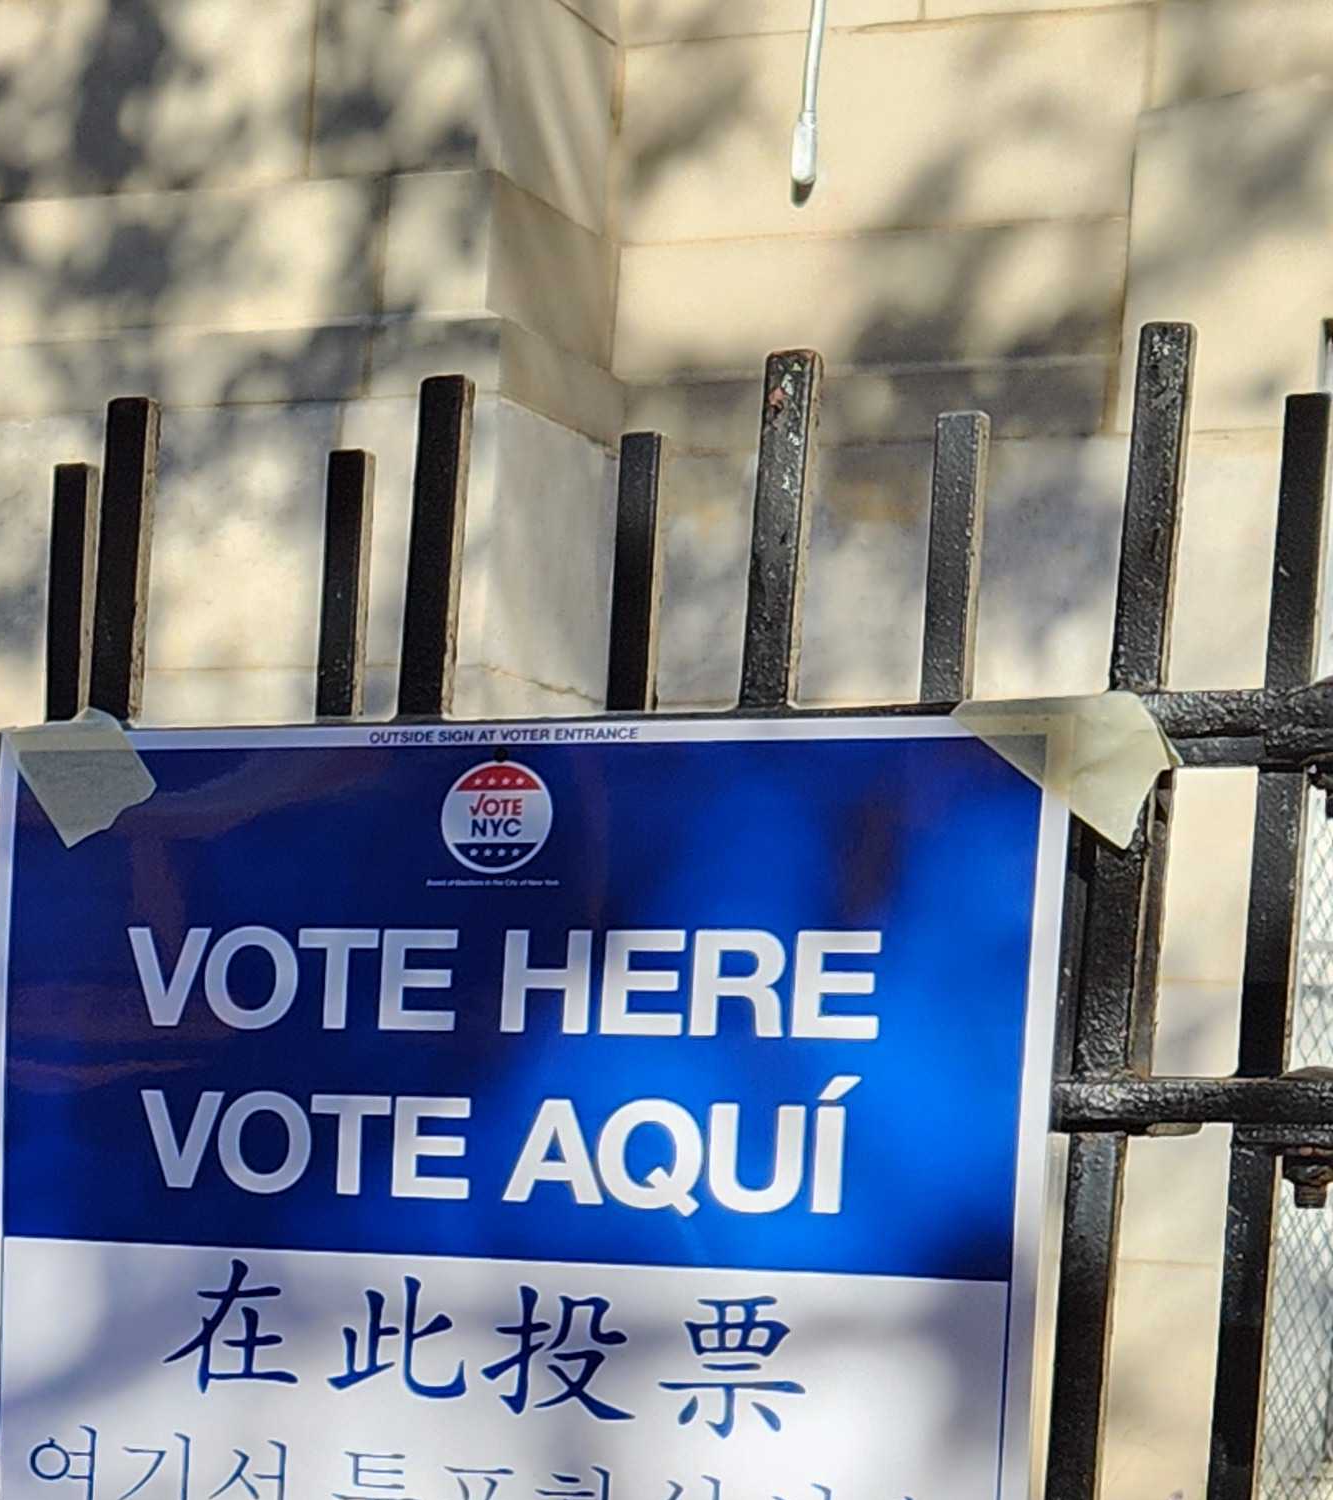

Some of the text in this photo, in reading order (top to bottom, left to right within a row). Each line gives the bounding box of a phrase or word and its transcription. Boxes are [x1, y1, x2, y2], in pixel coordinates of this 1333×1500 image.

[369, 727, 639, 744] OUTSIDE SIGN AT VOTER ENTRANCE
[469, 793, 523, 817] VOTE
[471, 818, 522, 837] NYC
[128, 926, 882, 1040] VOTE HERE
[141, 1075, 862, 1217] VOTE AQUÍ
[162, 1258, 806, 1438] 在此投票
